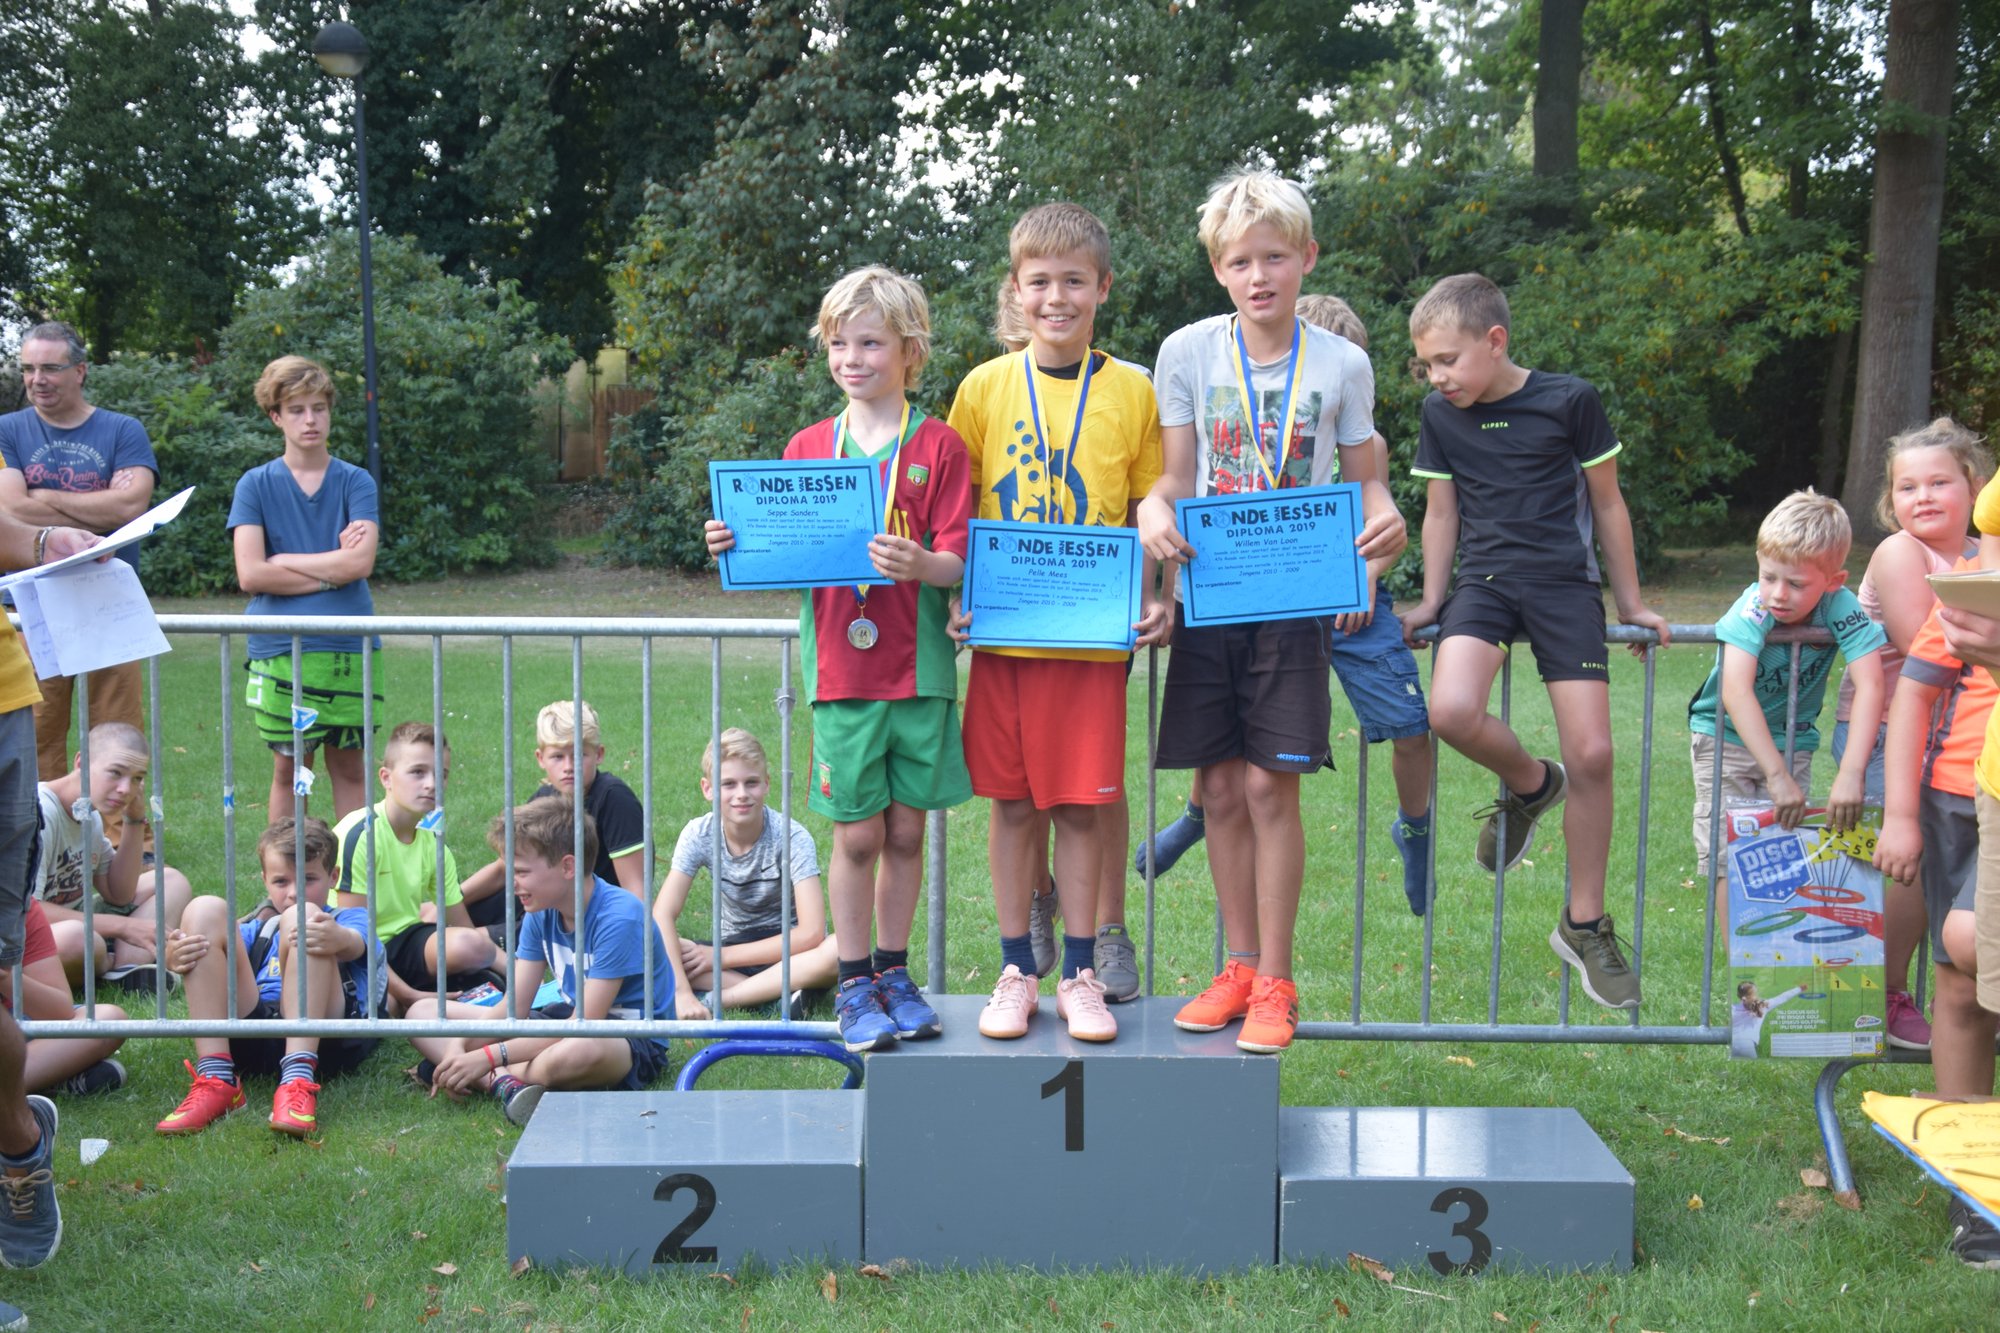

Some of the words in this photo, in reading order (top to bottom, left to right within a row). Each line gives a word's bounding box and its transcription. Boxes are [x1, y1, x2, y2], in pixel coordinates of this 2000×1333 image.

[1481, 421, 1509, 430] KIPSTA
[1213, 417, 1241, 459] IN
[1258, 421, 1305, 460] TE
[804, 475, 857, 493] ESSEN
[756, 495, 808, 505] DIPLOMA
[813, 494, 838, 504] 2019
[767, 509, 788, 517] Seppe
[1280, 502, 1337, 521] ESSEN
[1226, 525, 1284, 538] DIPLOMA
[1289, 521, 1316, 533] 2019
[1065, 540, 1119, 558] ESSEN
[1235, 539, 1261, 548] Willem
[1263, 538, 1278, 546] Van
[1280, 537, 1298, 545] Loon
[1011, 556, 1066, 567] DIPLOMA
[1071, 559, 1097, 569] 2019
[1028, 568, 1046, 577] Pelle
[1049, 571, 1068, 579] Mees
[1852, 844, 1863, 855] 5
[1865, 838, 1876, 849] 6
[1740, 840, 1798, 872] DISC
[1835, 980, 1840, 989] 1
[1041, 1061, 1084, 1151] 1
[652, 1173, 717, 1264] 2
[1428, 1187, 1492, 1276] 3
